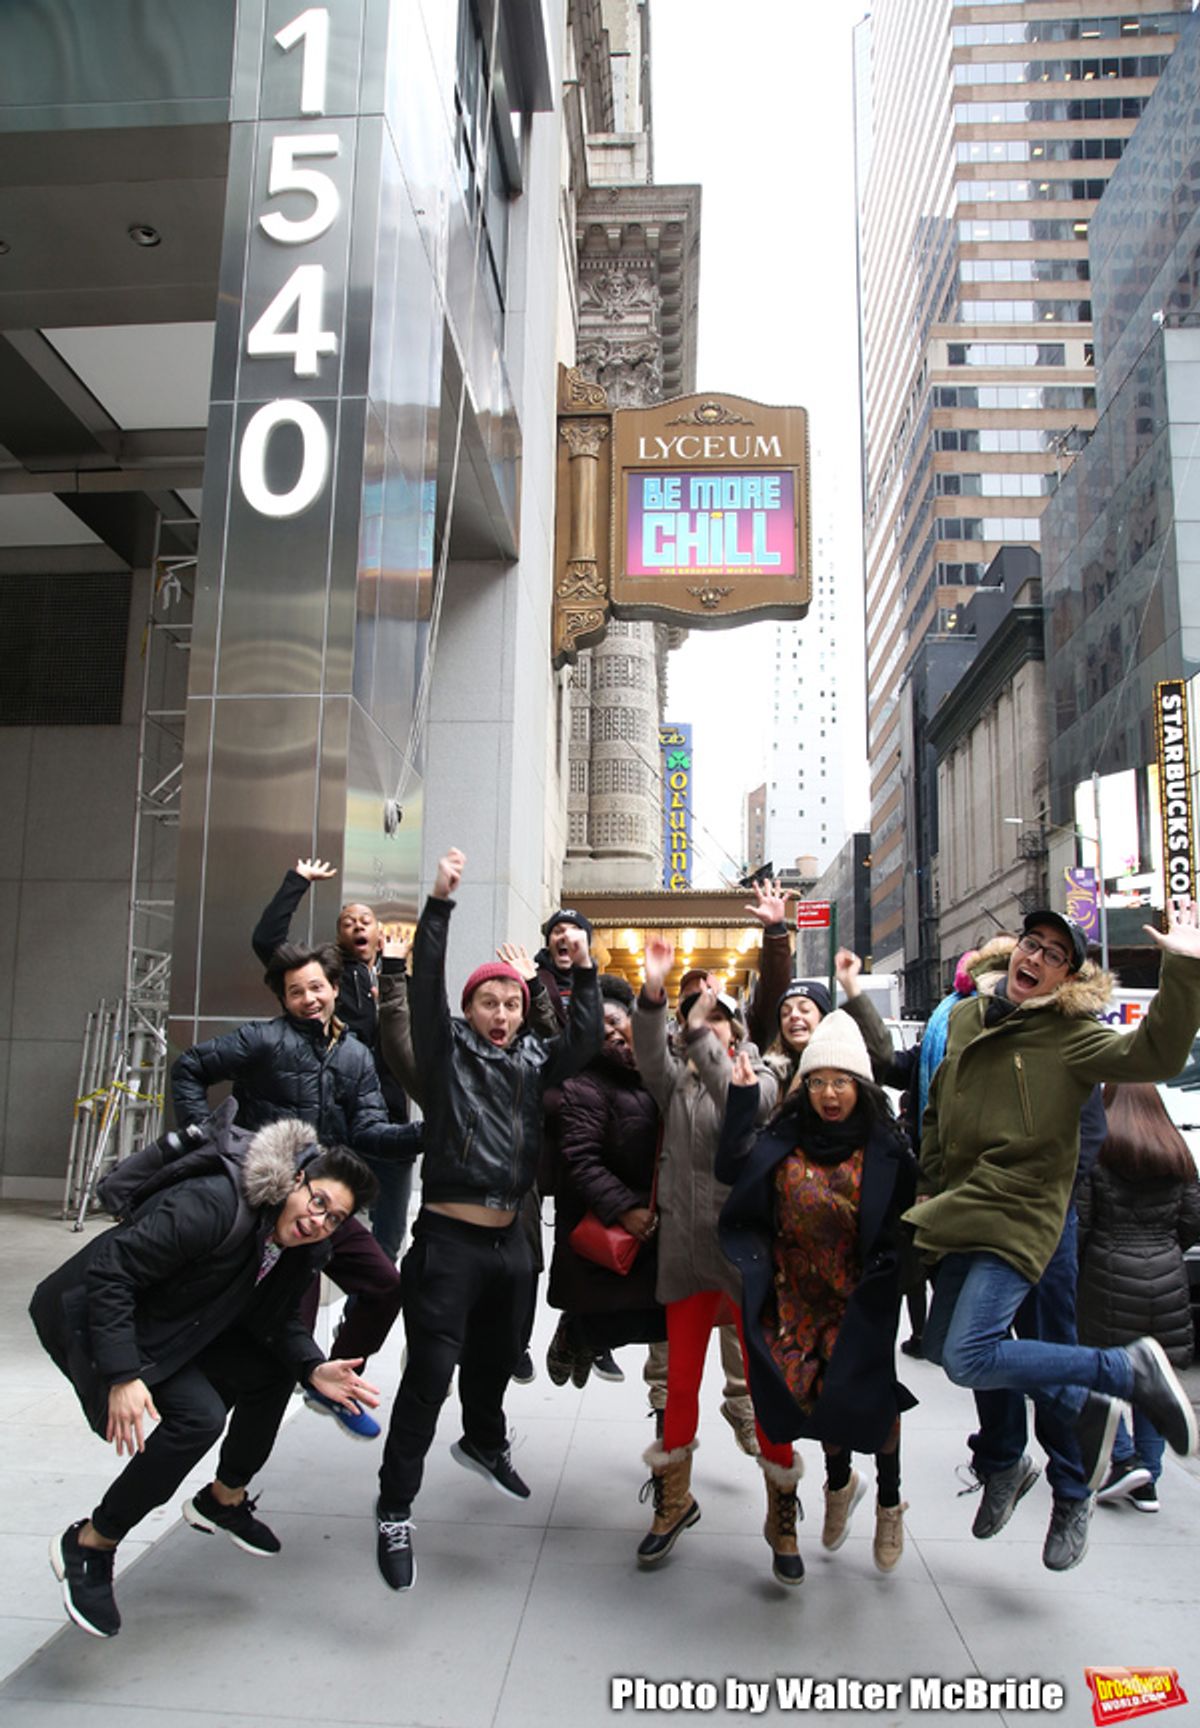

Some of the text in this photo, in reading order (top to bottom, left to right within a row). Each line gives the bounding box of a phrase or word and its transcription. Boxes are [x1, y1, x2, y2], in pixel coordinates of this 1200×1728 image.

[239, 7, 341, 518] 1540
[638, 435, 783, 460] LYCEUM
[643, 476, 781, 510] BE MORE
[1162, 694, 1189, 851] STARBUCKS
